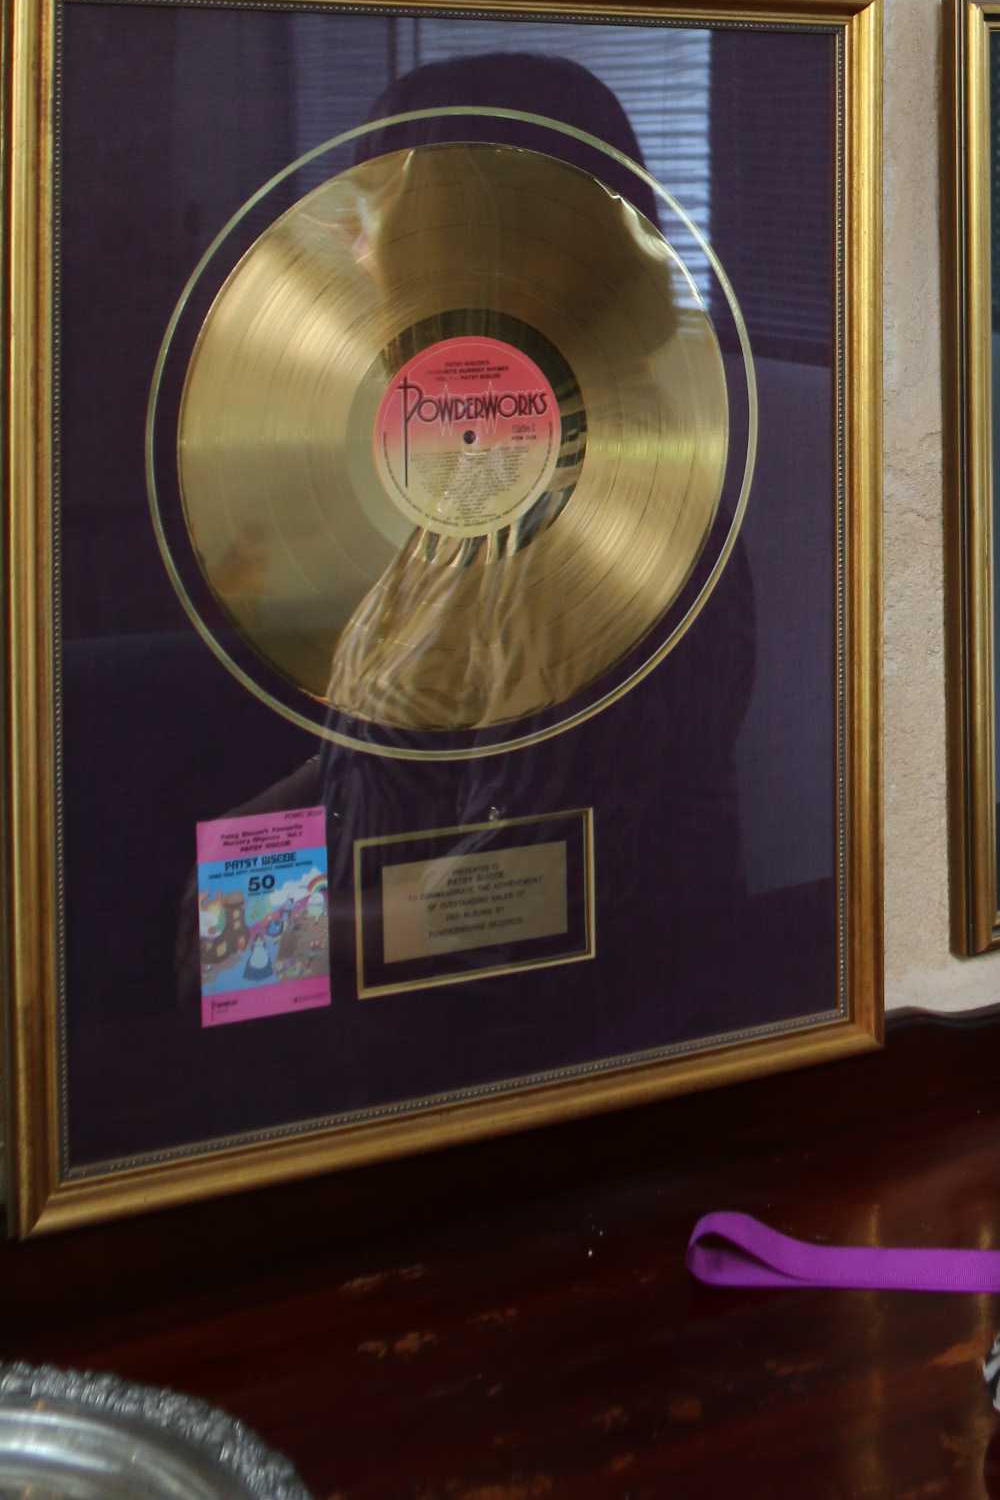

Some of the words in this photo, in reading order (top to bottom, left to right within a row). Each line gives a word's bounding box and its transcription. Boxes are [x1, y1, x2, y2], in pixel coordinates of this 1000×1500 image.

[225, 857, 258, 871] PATSY
[262, 852, 296, 866] BISCOE
[248, 874, 276, 892] 50
